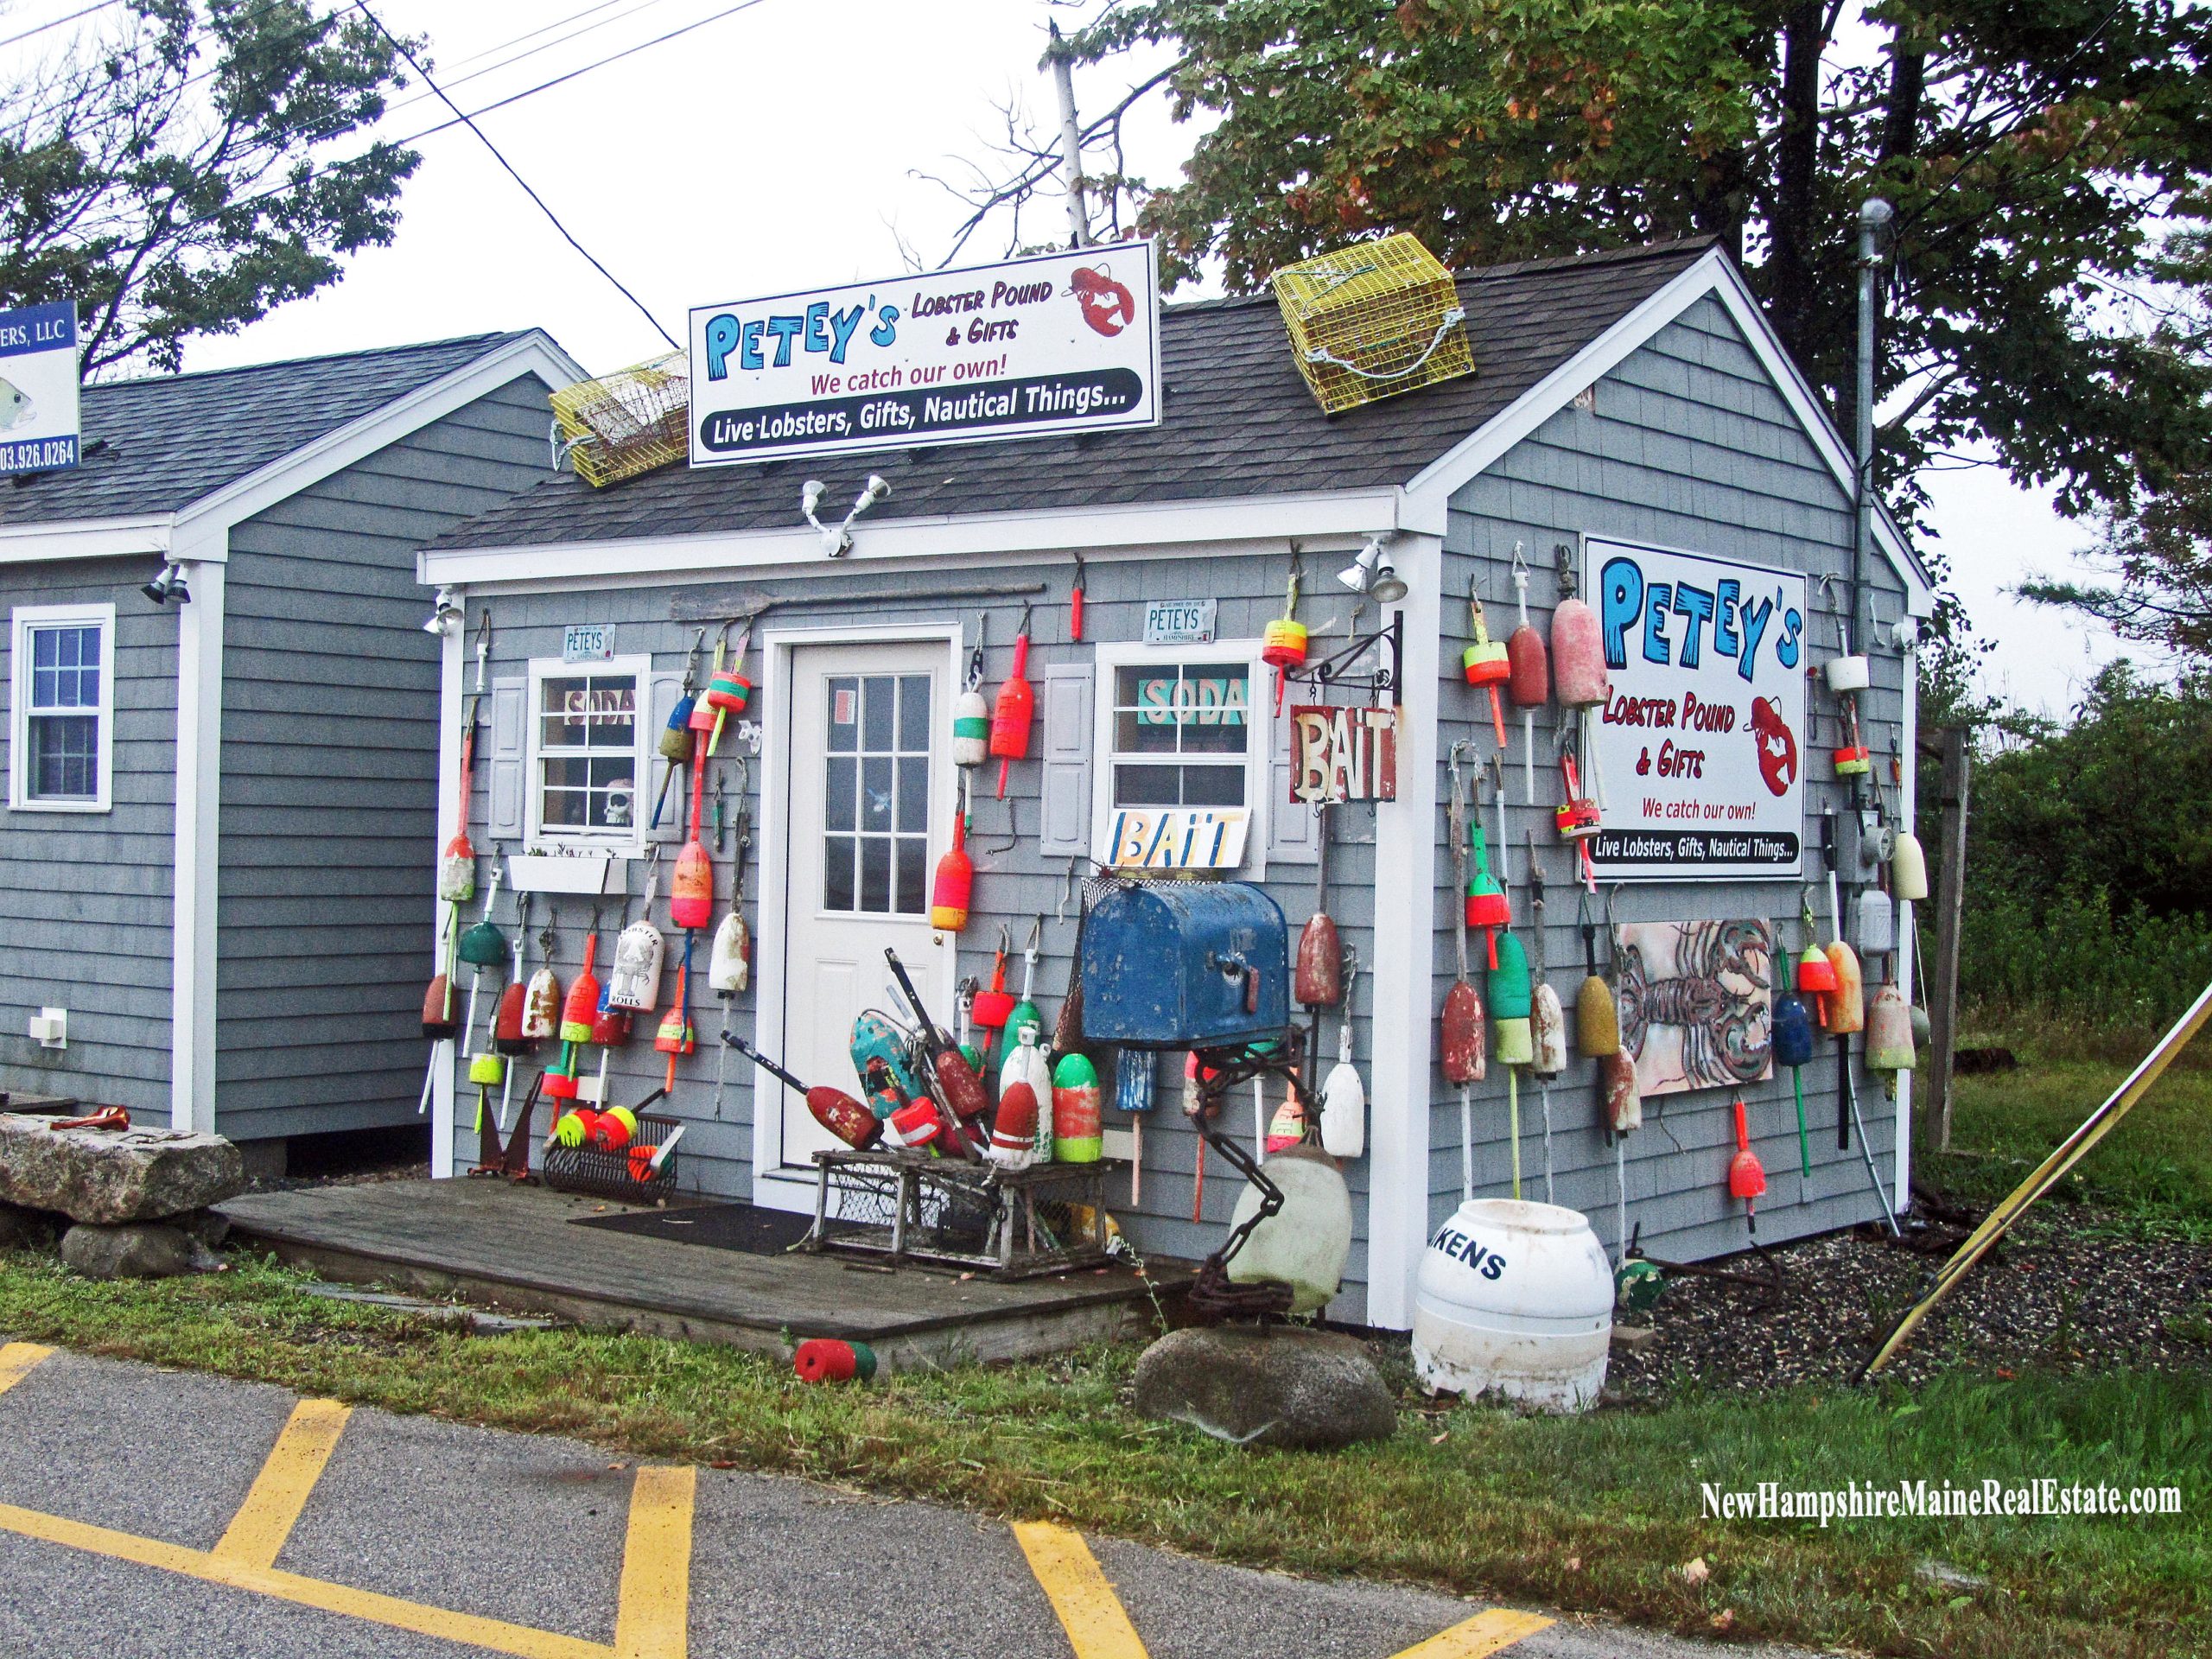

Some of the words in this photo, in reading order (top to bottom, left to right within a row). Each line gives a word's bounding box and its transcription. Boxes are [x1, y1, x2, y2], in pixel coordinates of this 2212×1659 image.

[991, 280, 1052, 308] POUND
[36, 320, 65, 341] LLC
[705, 294, 899, 382] PETEY'S
[946, 327, 959, 346] &
[967, 317, 1018, 346] GIFTS
[810, 374, 841, 396] We
[847, 365, 902, 391] catch
[910, 367, 946, 386] our
[953, 354, 1007, 381] own!
[713, 418, 753, 444] Live
[760, 408, 852, 441] Lobsters,
[860, 401, 916, 431] Gifts,
[924, 388, 1017, 424] Nautical
[1026, 380, 1126, 414] Things...
[1148, 608, 1198, 631] PETEYS
[1600, 556, 1802, 683] PETEY'S
[567, 632, 602, 651] PETEYS
[569, 690, 635, 725] SODA
[1144, 679, 1248, 724] SODA
[1681, 691, 1735, 734] POUND
[1637, 747, 1651, 777] &
[1657, 738, 1705, 779] GIFTS
[1643, 797, 1662, 819] We
[1666, 798, 1700, 820] catch
[1703, 803, 1725, 820] our
[1727, 802, 1757, 821] own!
[1595, 836, 1619, 857] Live
[1623, 836, 1675, 861] Lobsters,
[1677, 838, 1706, 861] Gifts,
[1709, 837, 1751, 859] Nautical
[1753, 838, 1794, 861] Things...
[612, 996, 640, 1007] ROLLS
[1430, 1227, 1507, 1281] KENS
